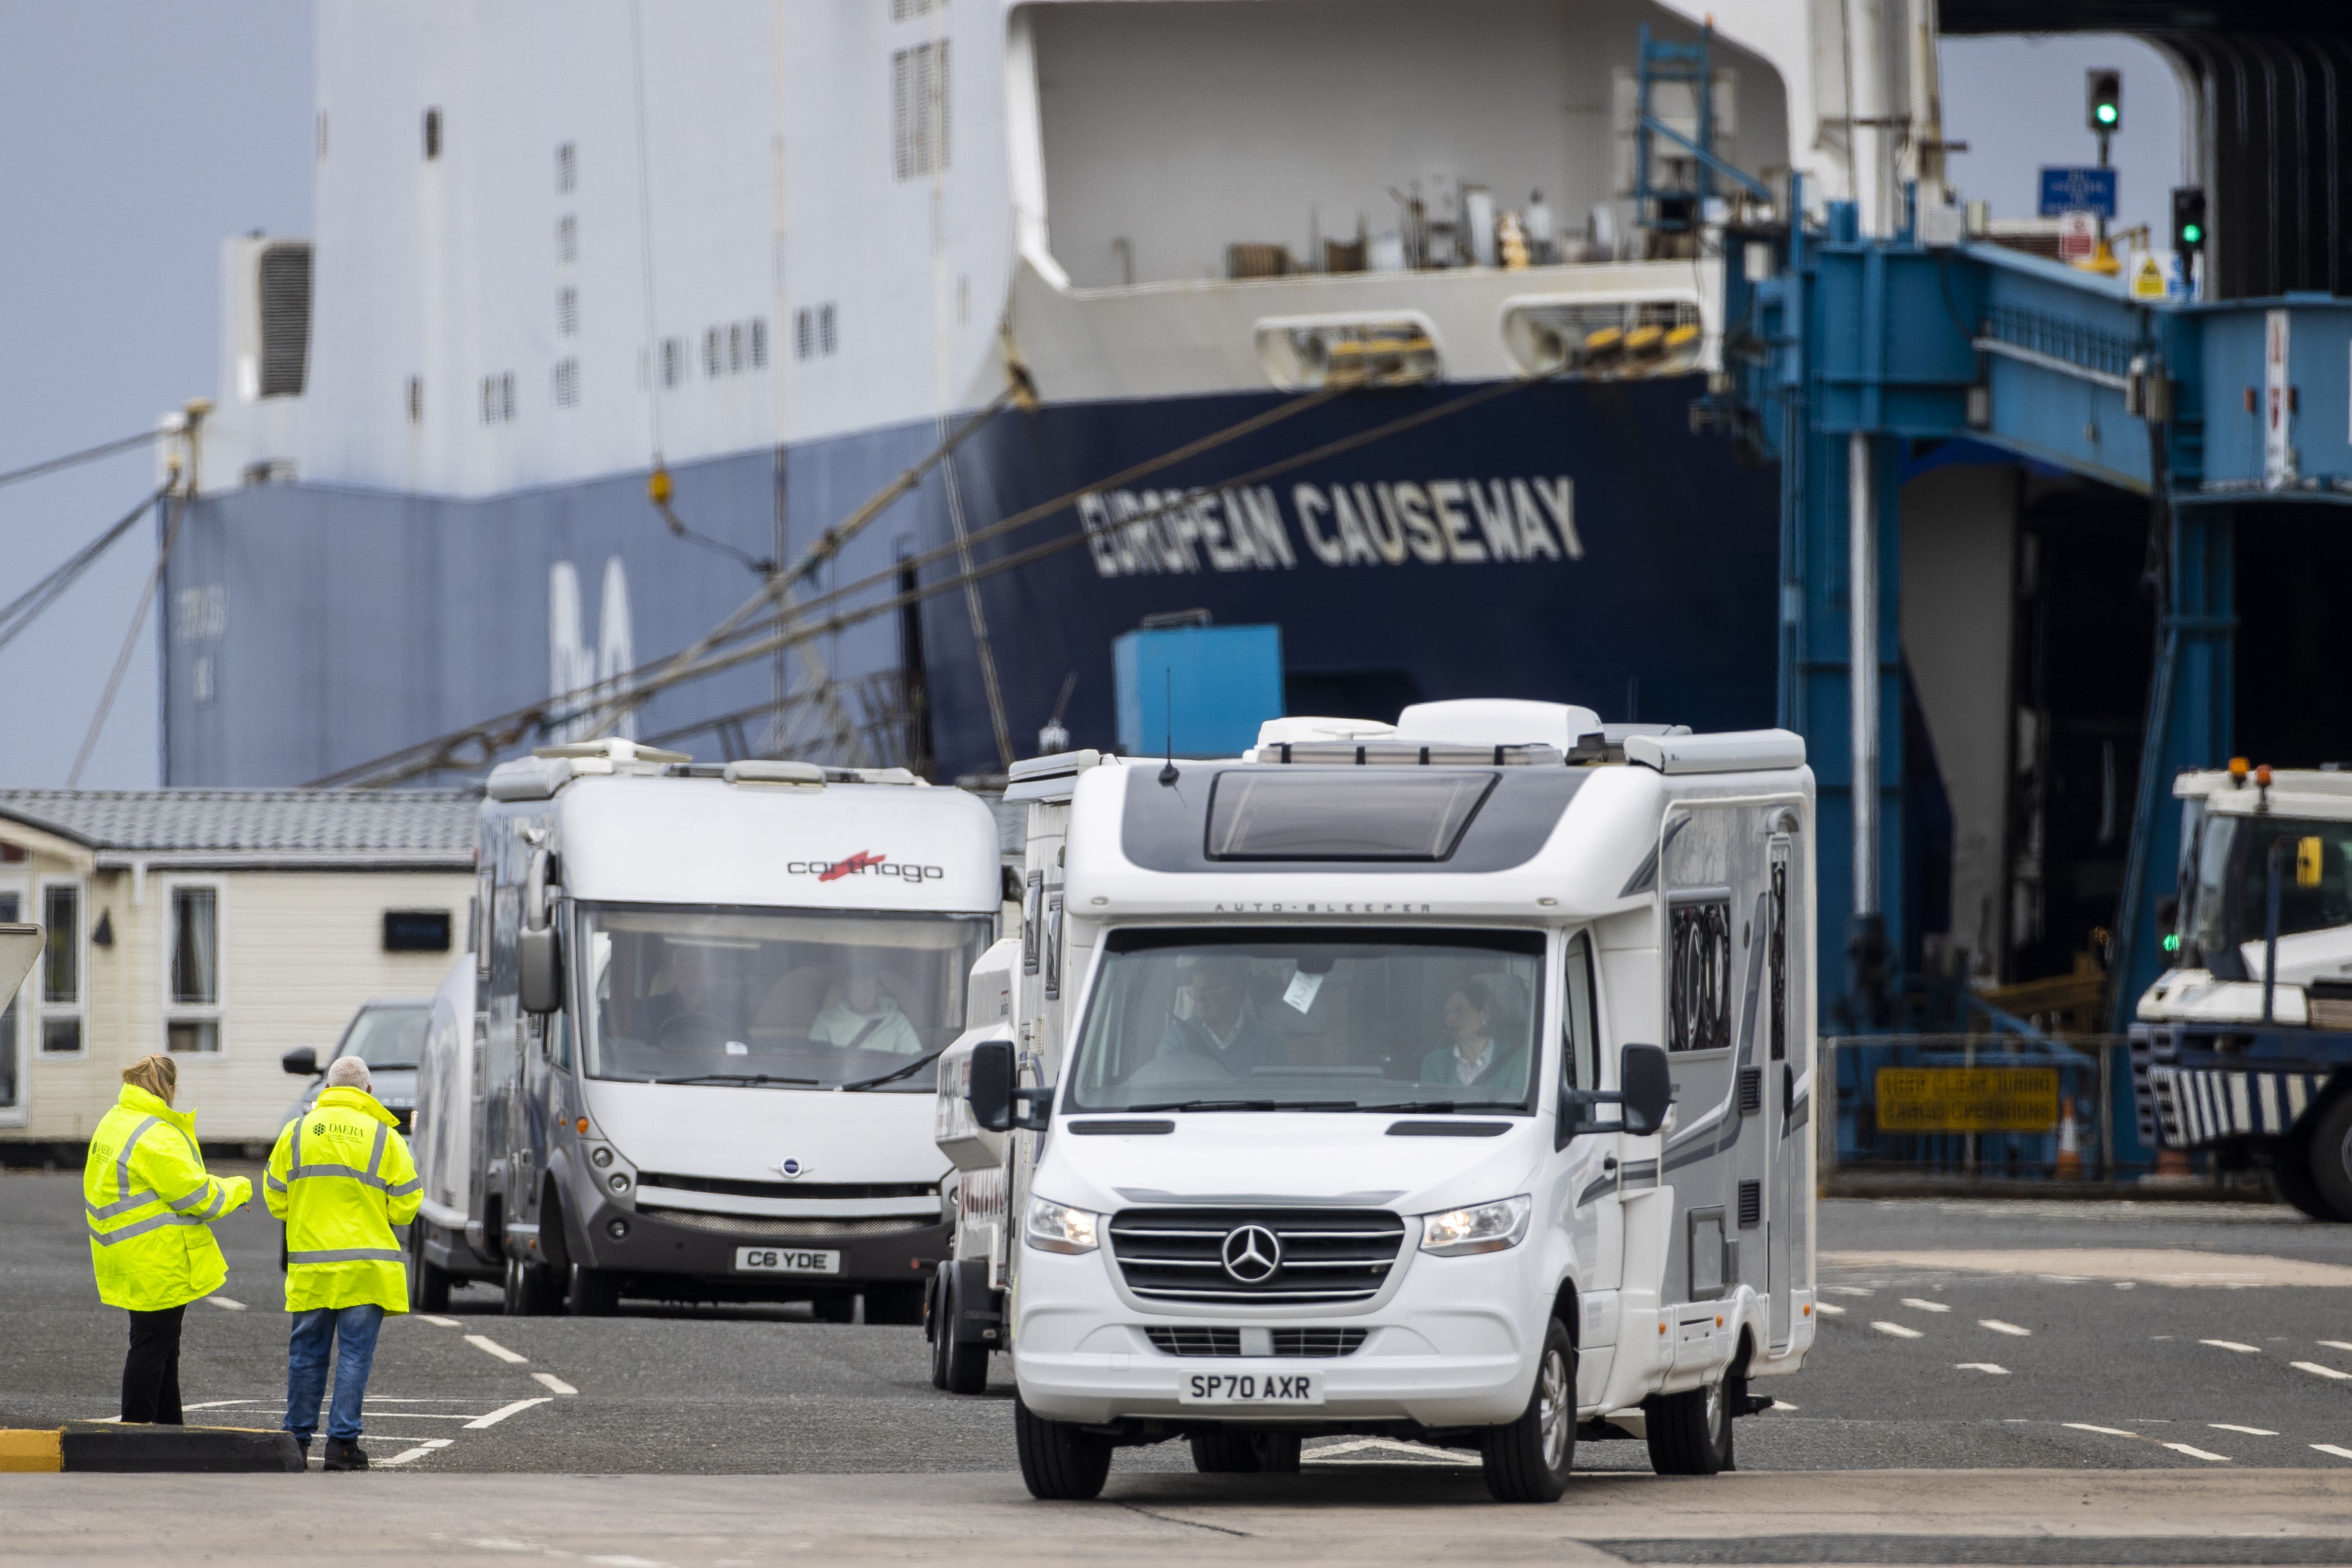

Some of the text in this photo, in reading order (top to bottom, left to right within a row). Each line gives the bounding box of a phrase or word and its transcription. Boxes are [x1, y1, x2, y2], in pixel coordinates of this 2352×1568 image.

[1076, 476, 1583, 577] EUROPEAN CAUSEWAY
[787, 858, 944, 883] carthago
[1214, 902, 1431, 914] AUTO-SLEEPER
[329, 1123, 364, 1138] DAERA
[747, 1251, 828, 1270] C6 YDE
[1191, 1375, 1311, 1399] SP70 AXR
